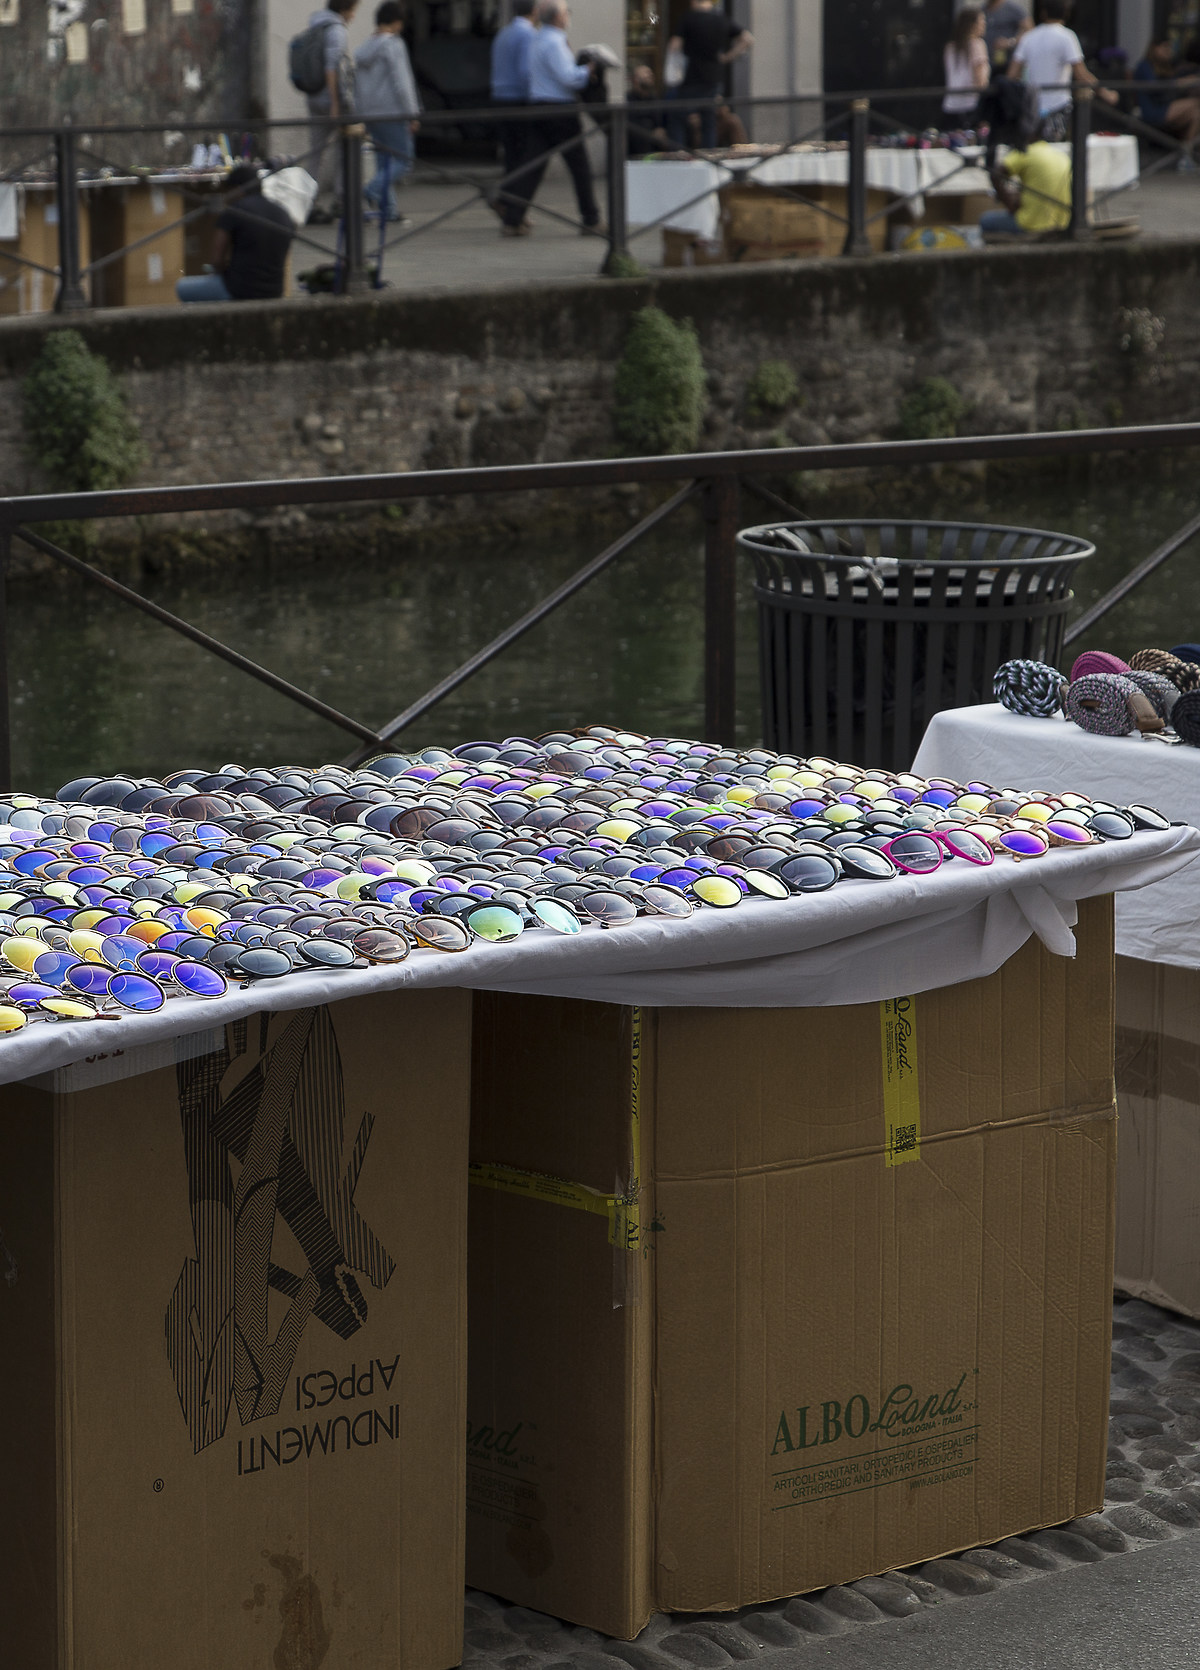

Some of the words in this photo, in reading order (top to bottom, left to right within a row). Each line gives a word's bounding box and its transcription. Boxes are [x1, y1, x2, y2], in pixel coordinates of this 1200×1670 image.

[296, 1354, 401, 1411] APPESI
[237, 1404, 400, 1476] INDUMENTI
[902, 1422, 936, 1437] BOLOGNA
[942, 1413, 963, 1427] ITALIA
[773, 1474, 817, 1492] ARTICOLI
[818, 1463, 861, 1482] SANITARI,
[863, 1451, 916, 1471] ORTOPEDICI
[926, 1433, 979, 1456] OSPEDALIERI
[791, 1477, 852, 1500] ORTHOPEDIC
[853, 1471, 873, 1485] AND
[874, 1460, 917, 1482] SANITARY
[918, 1449, 963, 1471] PRODUCTS
